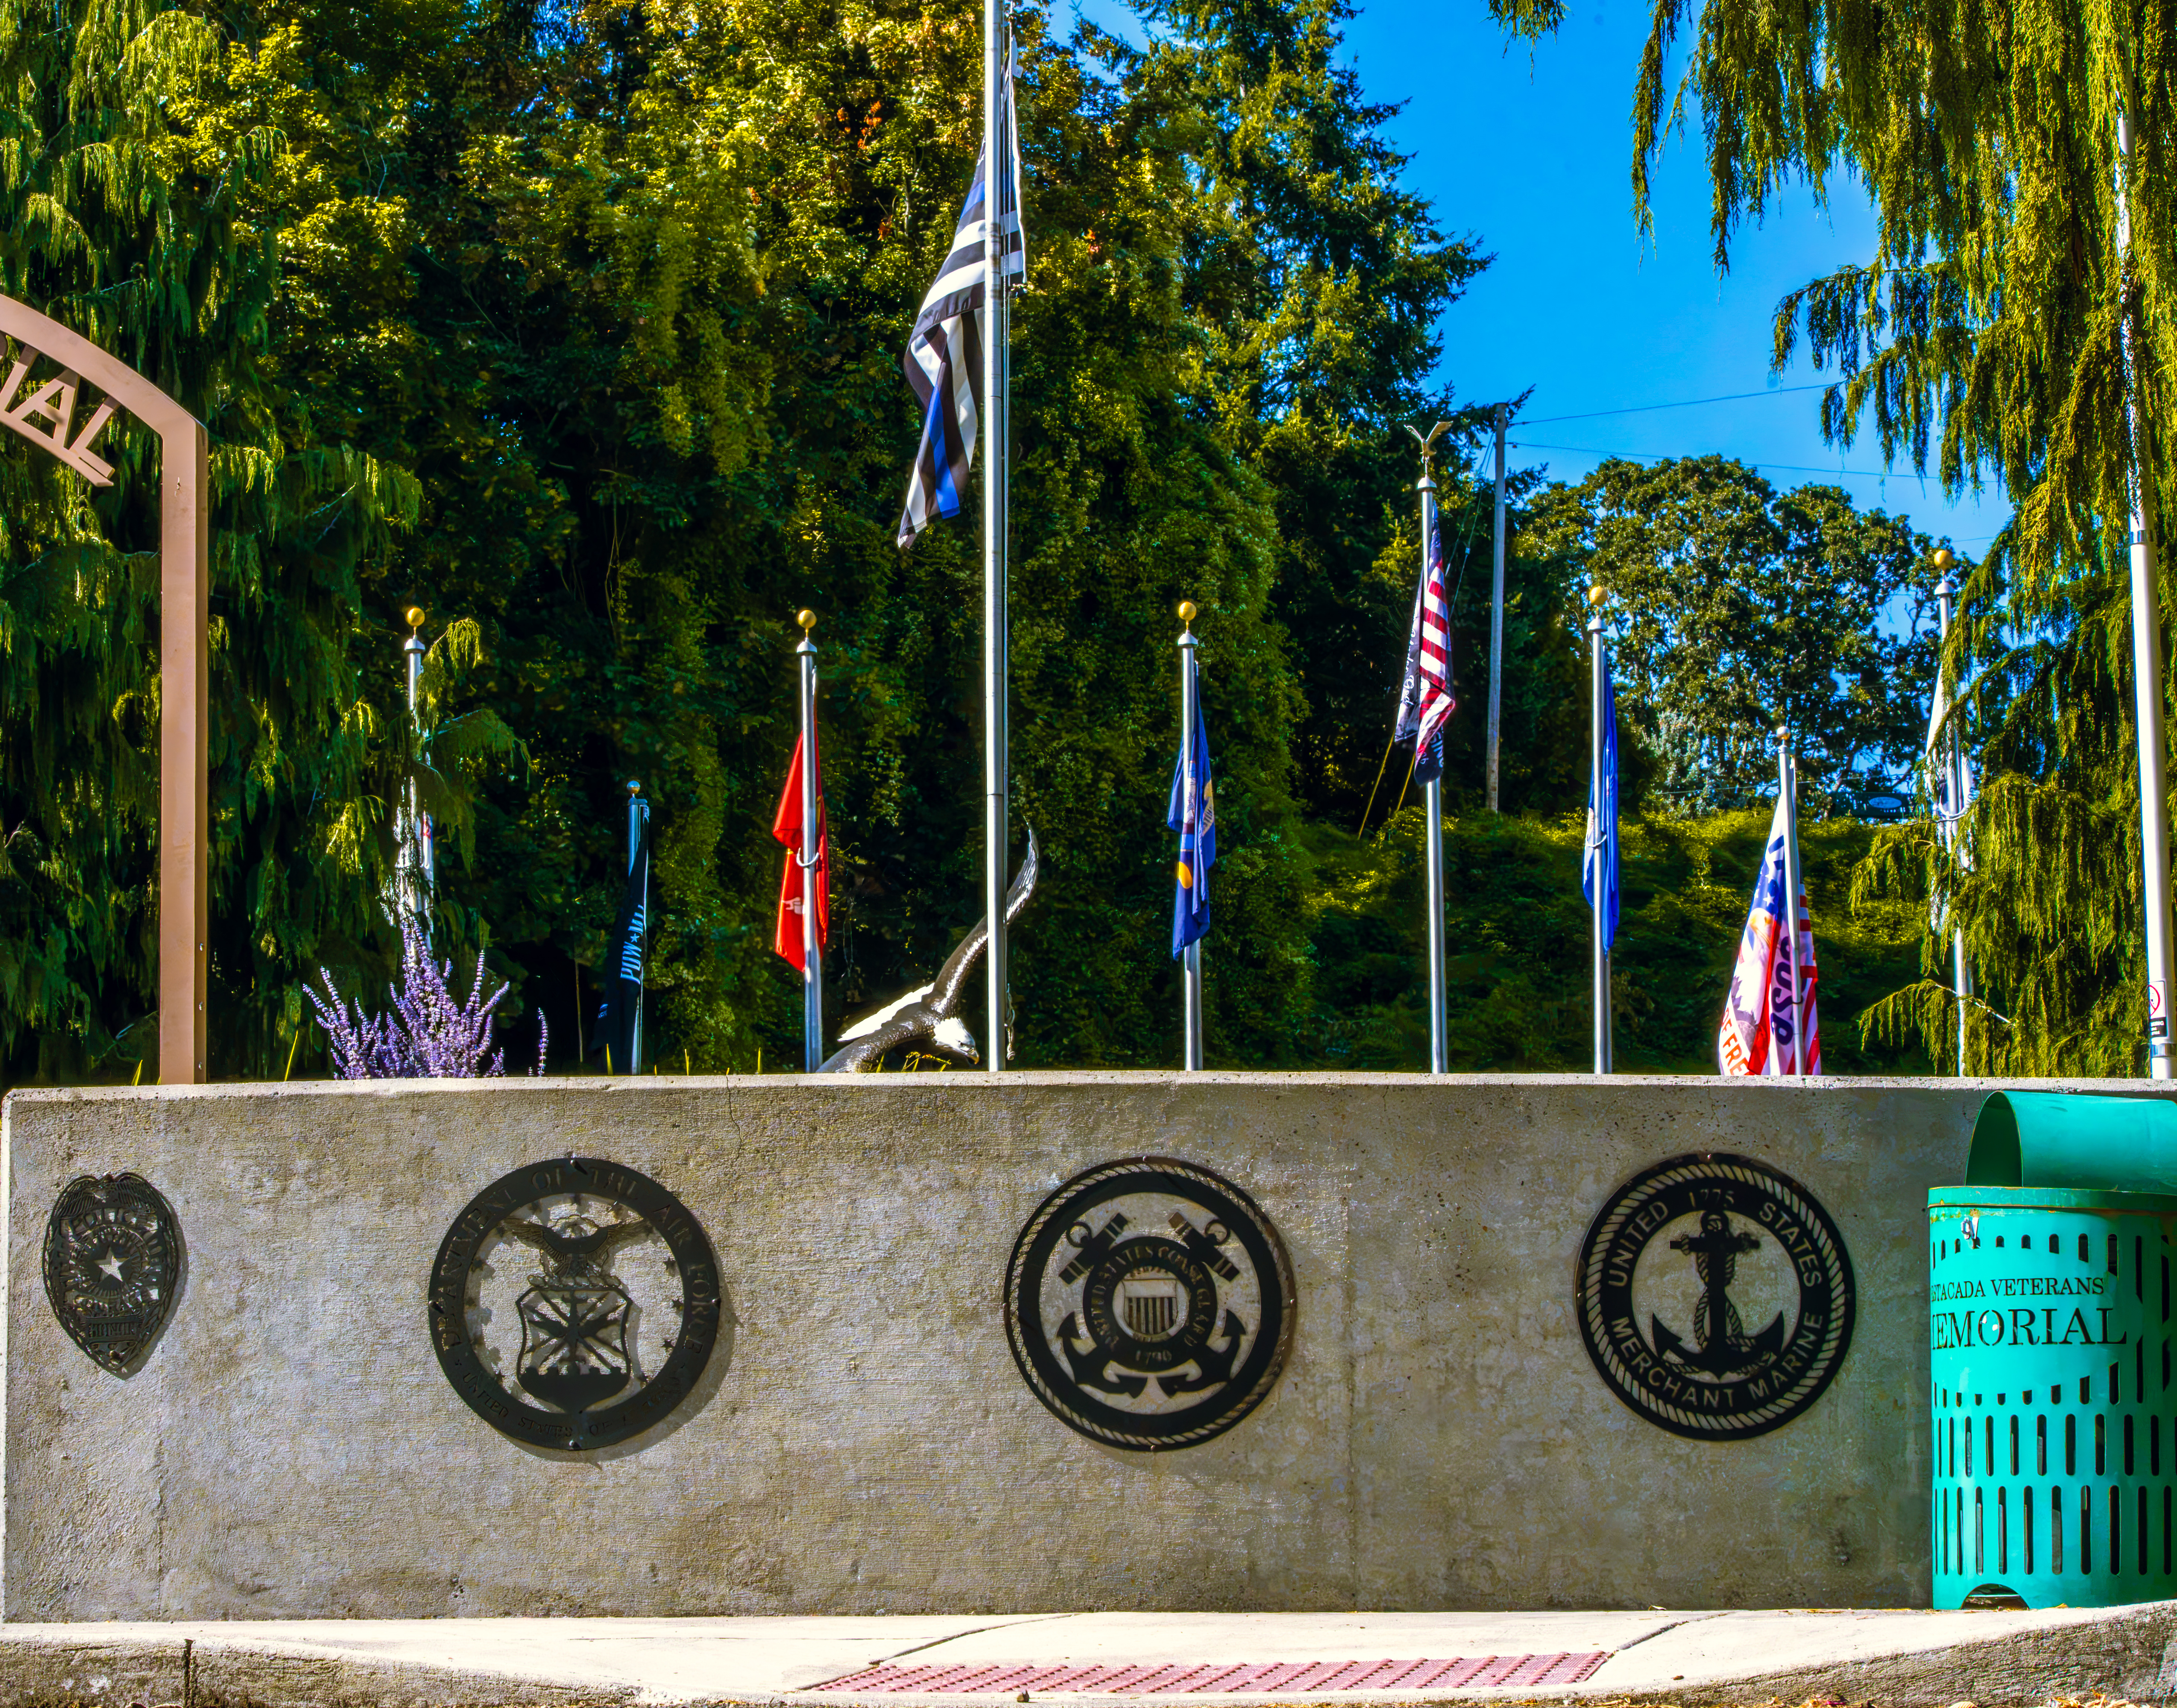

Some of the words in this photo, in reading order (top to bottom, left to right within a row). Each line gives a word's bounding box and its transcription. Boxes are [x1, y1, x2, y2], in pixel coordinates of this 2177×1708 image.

[620, 941, 642, 985] POW
[1722, 1007, 1732, 1033] OF
[1722, 1032, 1752, 1075] FRE
[1689, 1189, 1734, 1208] 1775
[1609, 1201, 1669, 1288] UNITED
[1759, 1202, 1823, 1288] STATES
[438, 1186, 516, 1351] DEARTMENT
[653, 1204, 693, 1247] AIR
[683, 1263, 711, 1354] FORCE
[1991, 1277, 2104, 1296] VETERANS
[1611, 1316, 1734, 1407] MERCHANT
[1748, 1312, 1822, 1401] MARINE
